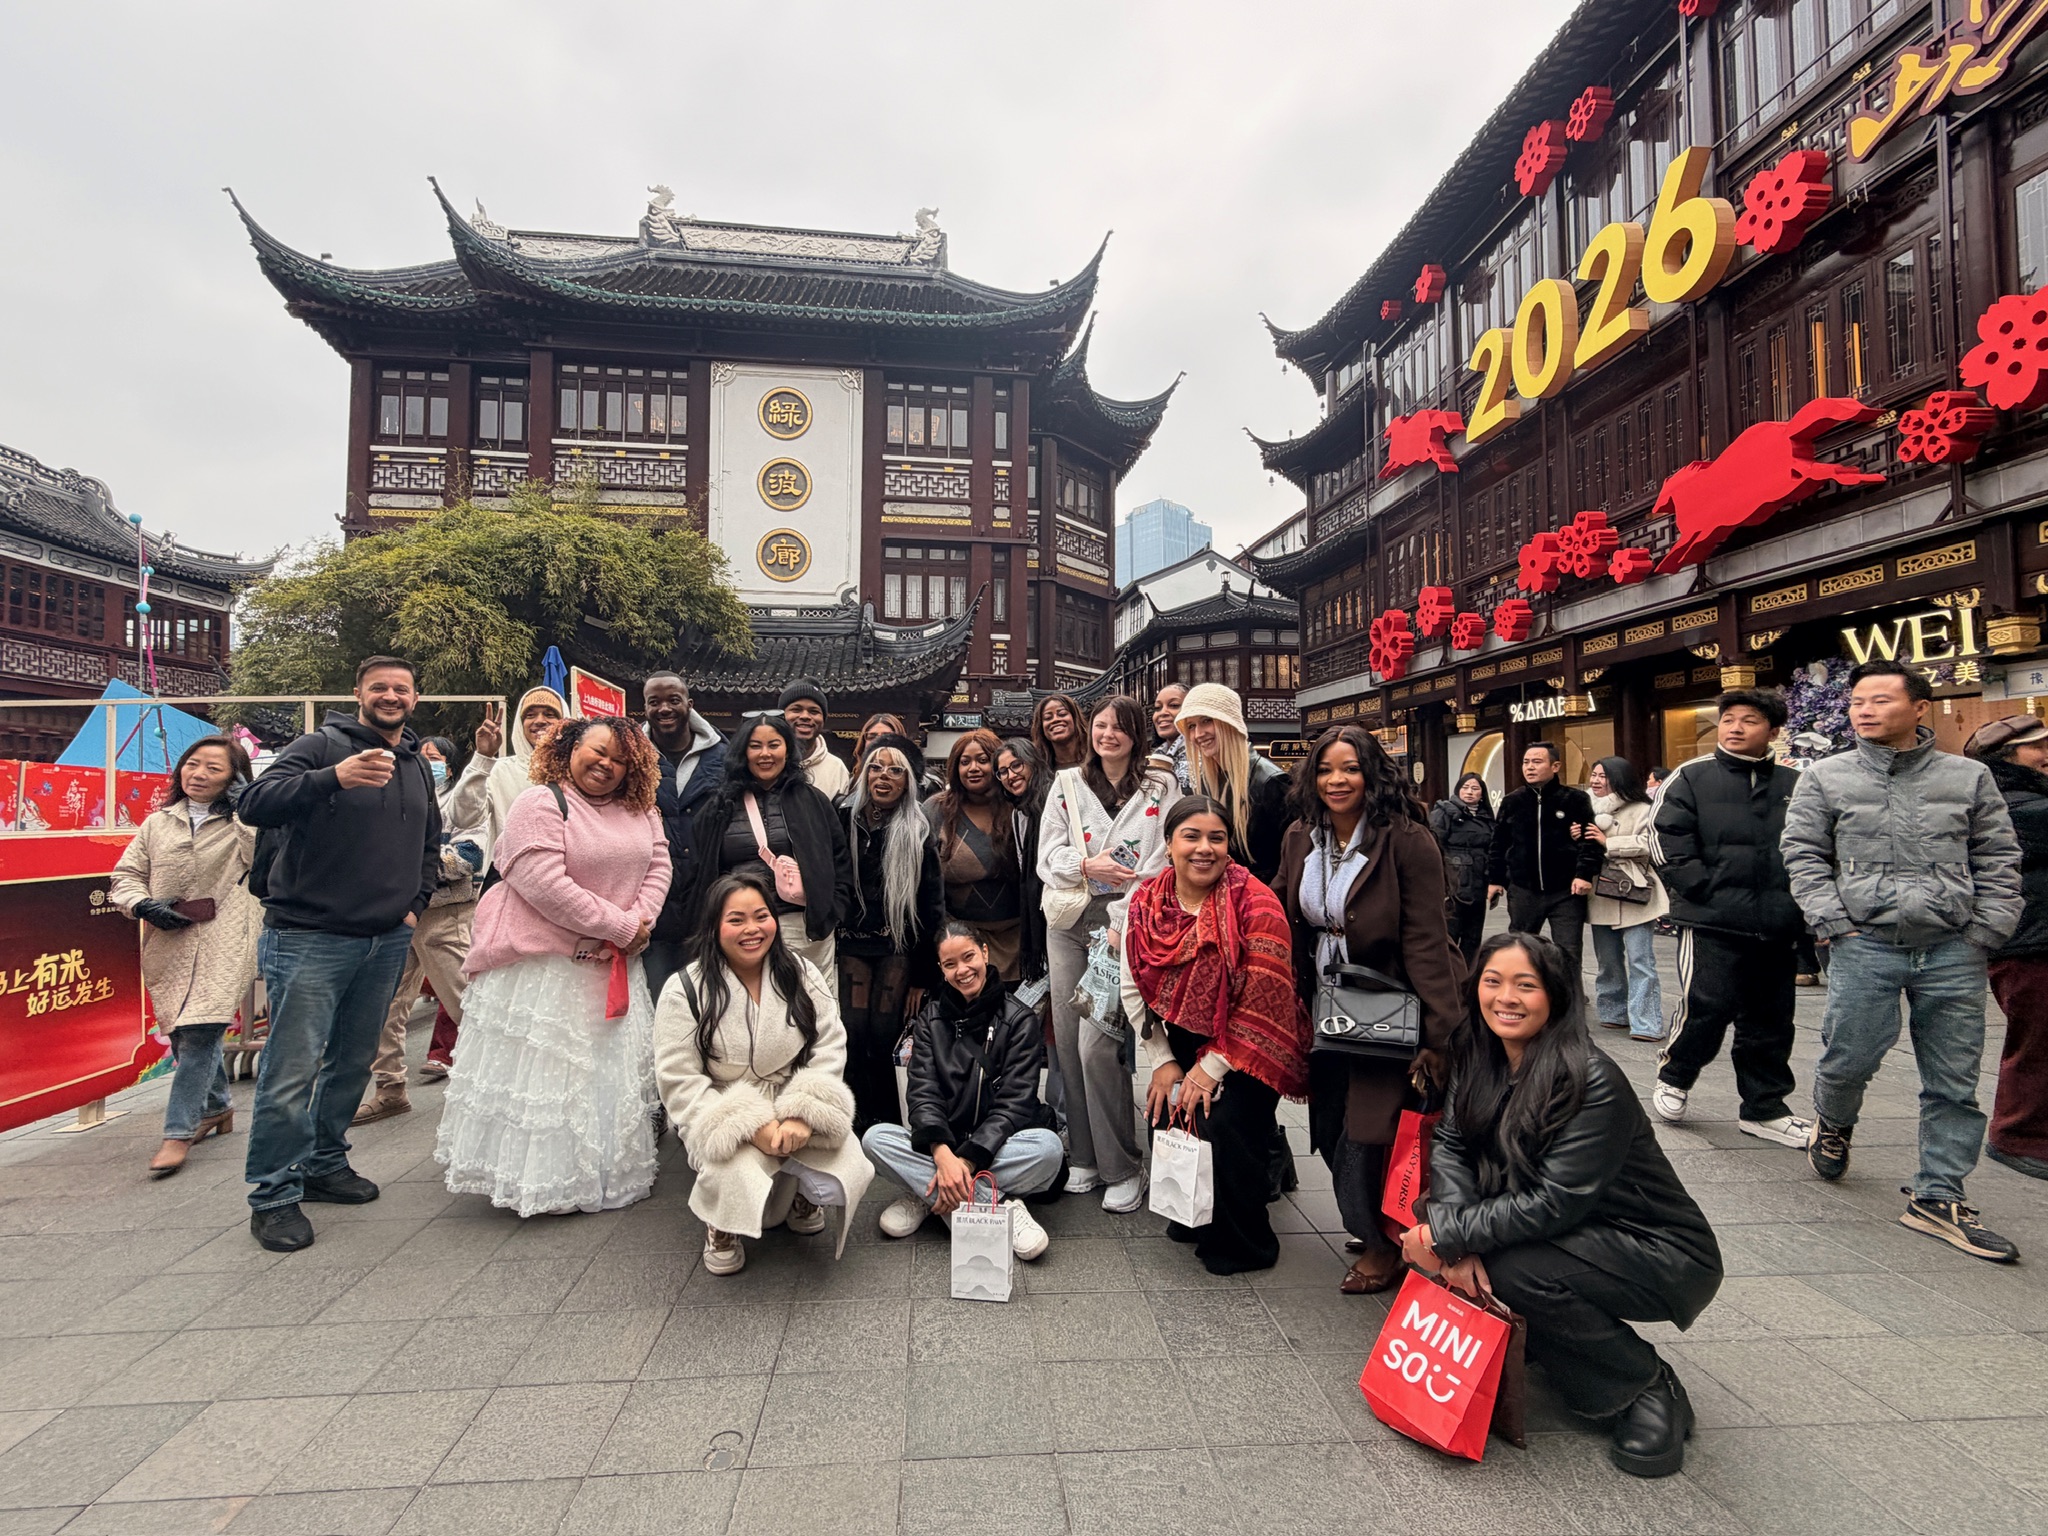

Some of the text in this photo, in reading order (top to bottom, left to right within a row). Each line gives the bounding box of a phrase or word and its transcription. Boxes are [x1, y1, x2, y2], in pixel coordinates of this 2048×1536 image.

[1466, 146, 1735, 444] 2026
[1841, 608, 1980, 666] WEI
[26, 976, 115, 1018] 好运发生
[1401, 1299, 1483, 1370] MINI
